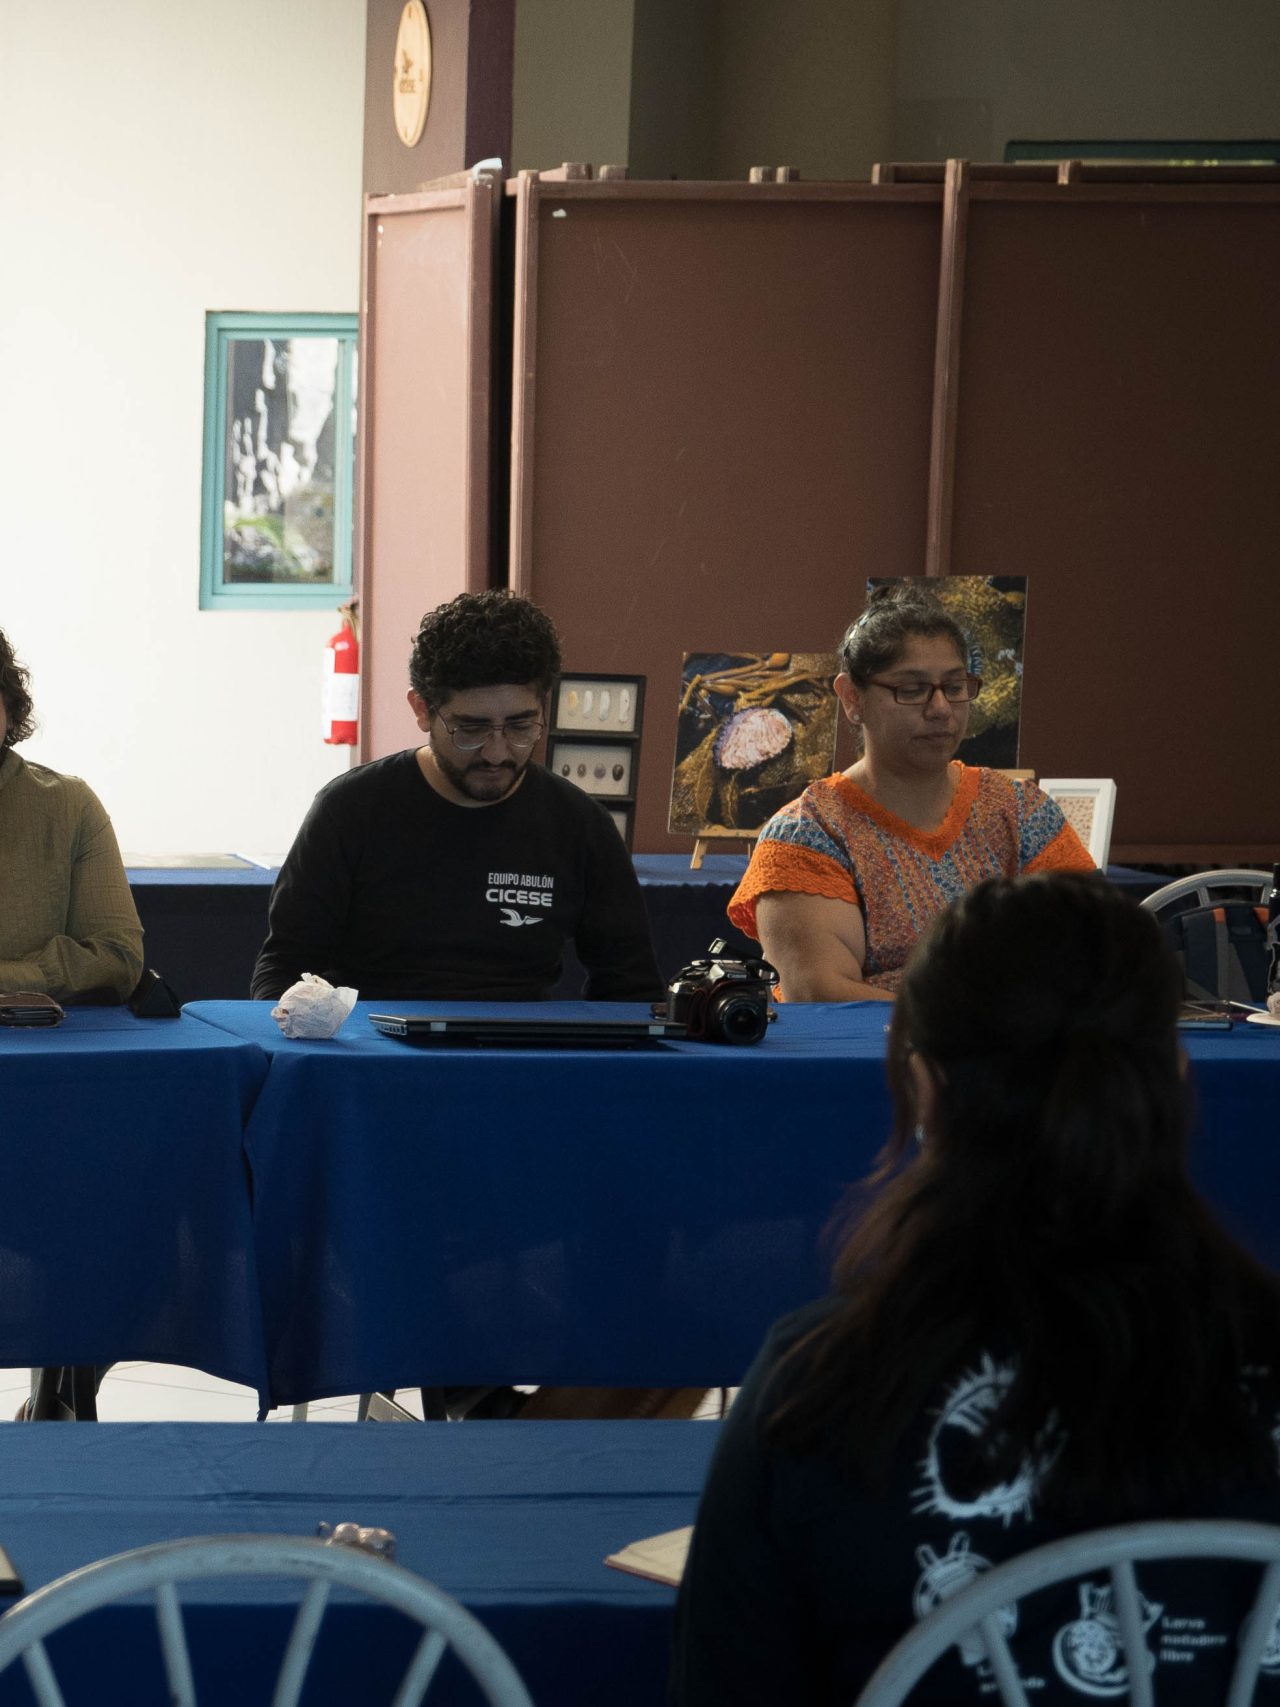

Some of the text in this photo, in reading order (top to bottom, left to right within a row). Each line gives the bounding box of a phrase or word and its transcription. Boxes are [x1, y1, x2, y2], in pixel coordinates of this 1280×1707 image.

[488, 872, 554, 889] EQUIPO ABULÓN
[485, 888, 553, 907] CICESE
